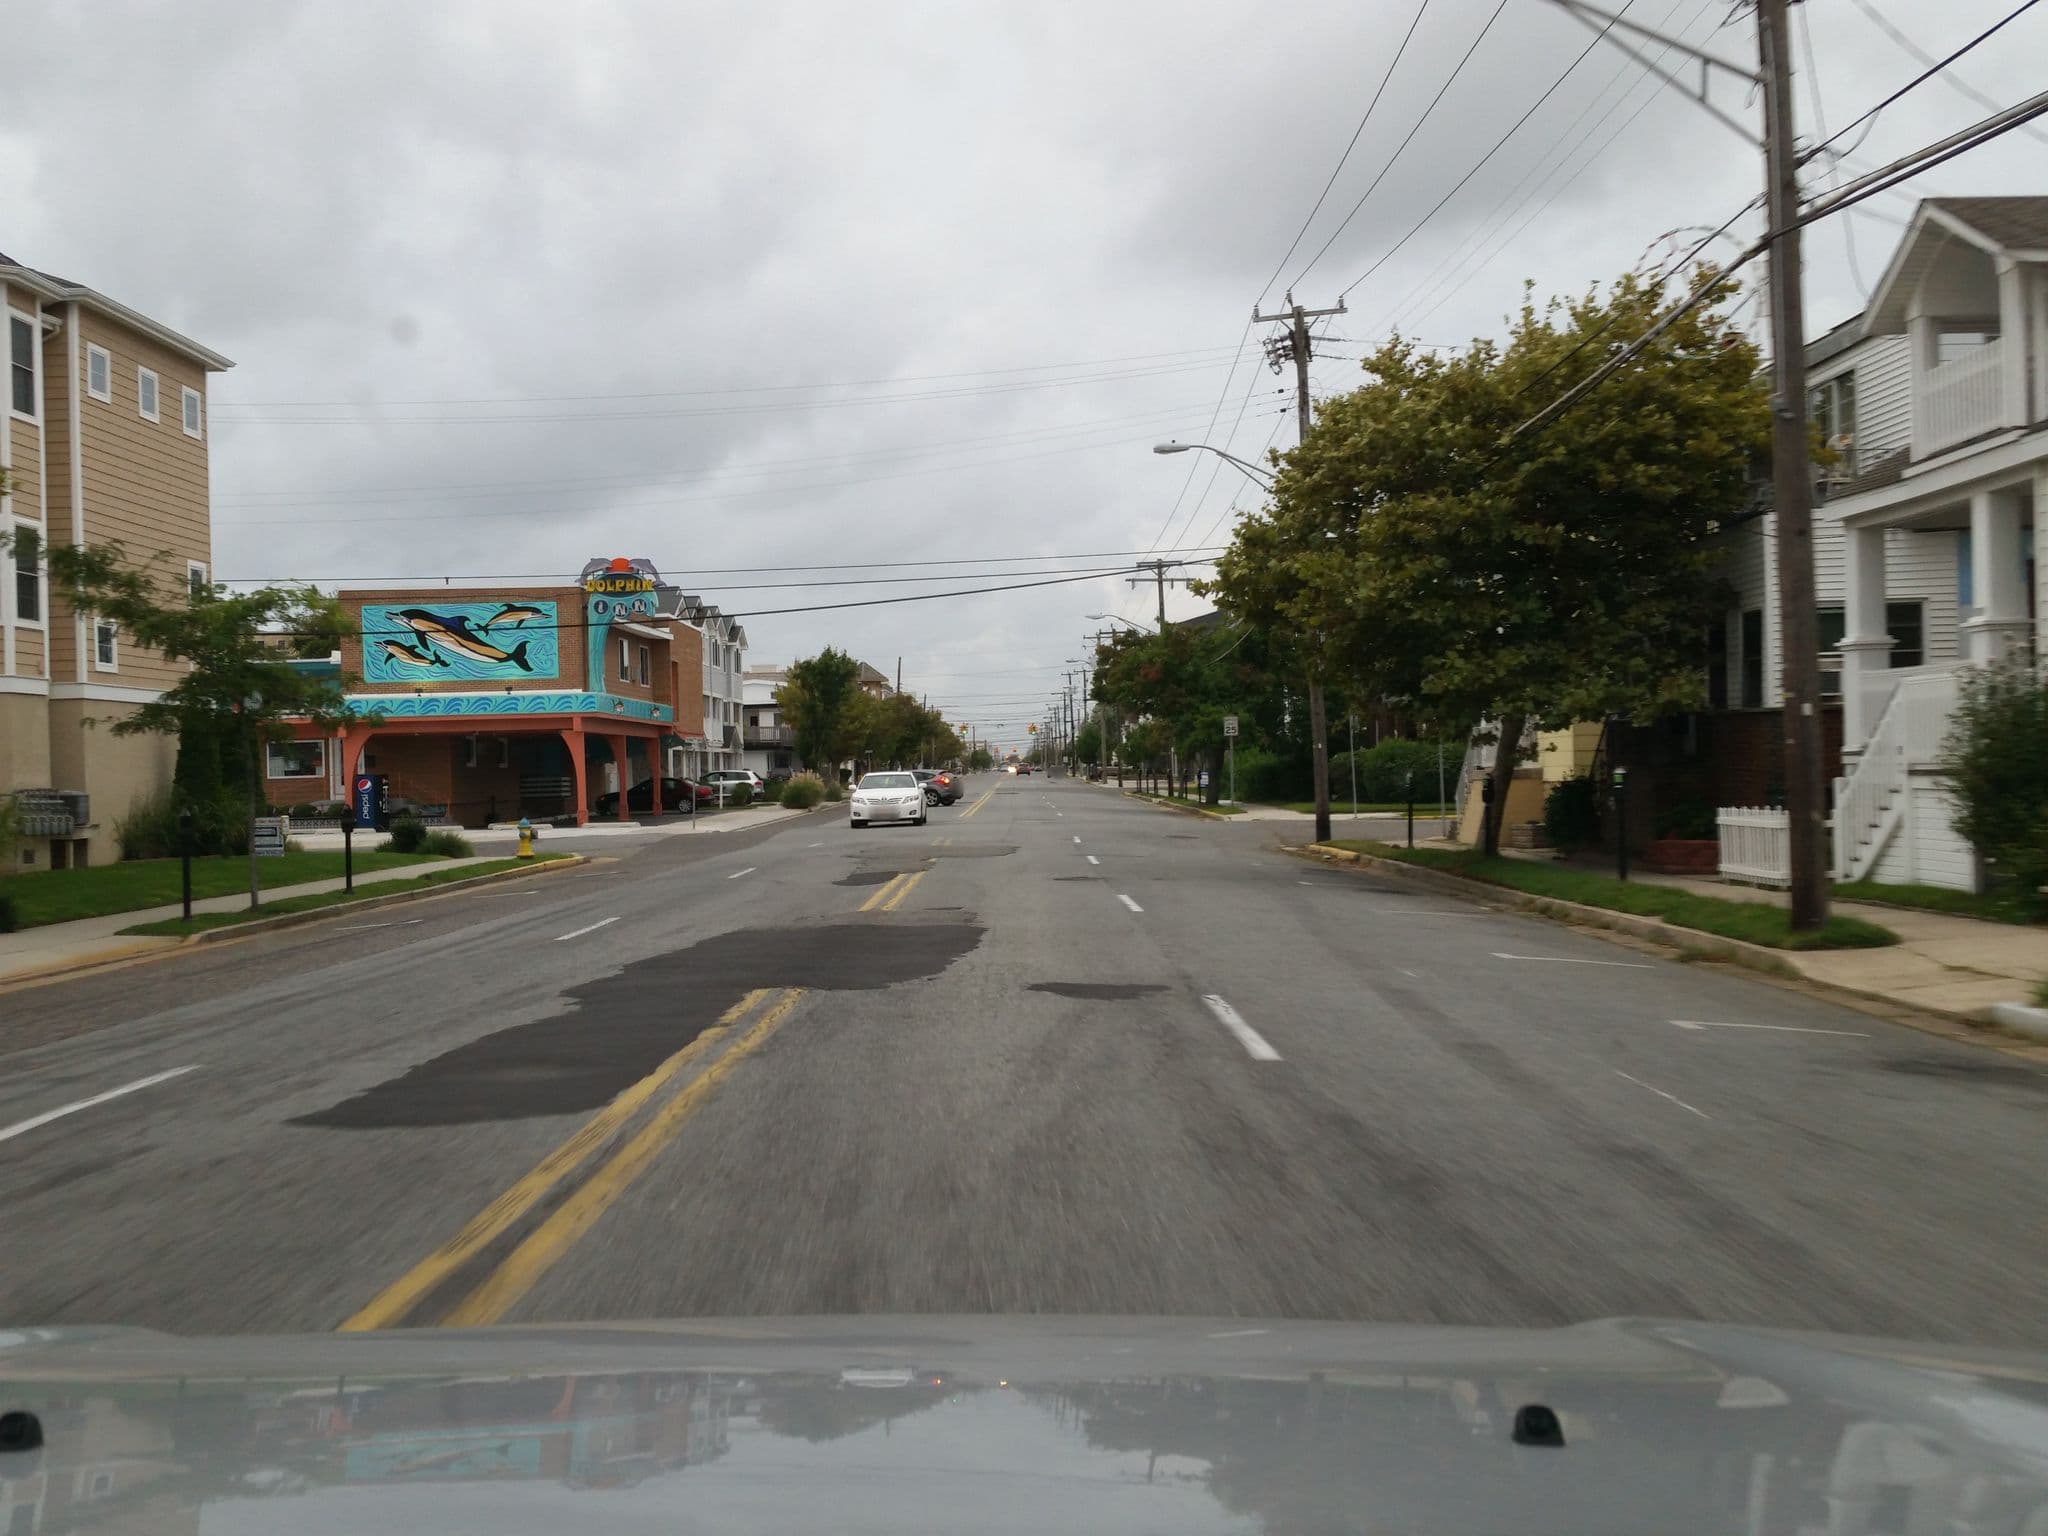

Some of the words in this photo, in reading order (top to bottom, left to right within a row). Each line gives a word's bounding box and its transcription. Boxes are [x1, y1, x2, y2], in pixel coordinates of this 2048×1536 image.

[586, 579, 655, 592] DOLPHIN
[597, 600, 646, 616] INN
[1225, 726, 1237, 735] 25
[361, 794, 370, 819] pepsi
